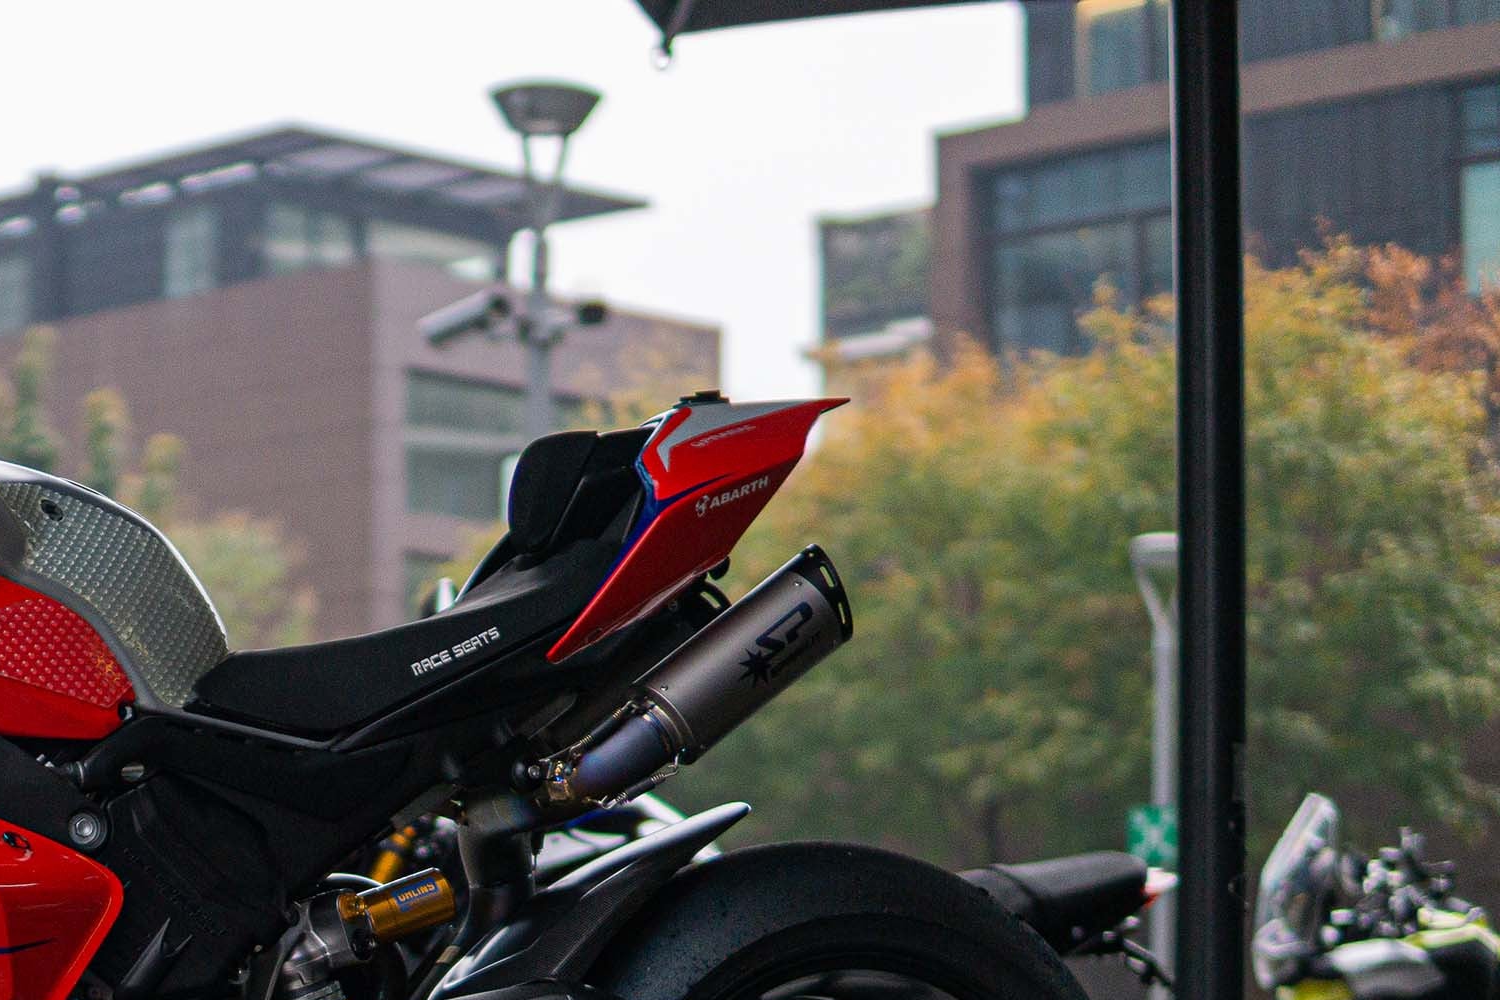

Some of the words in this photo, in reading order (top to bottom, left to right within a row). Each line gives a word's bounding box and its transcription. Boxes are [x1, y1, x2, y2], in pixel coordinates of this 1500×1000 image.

[708, 476, 769, 510] ABARTH
[410, 649, 452, 676] RACE
[451, 626, 500, 658] SEATS
